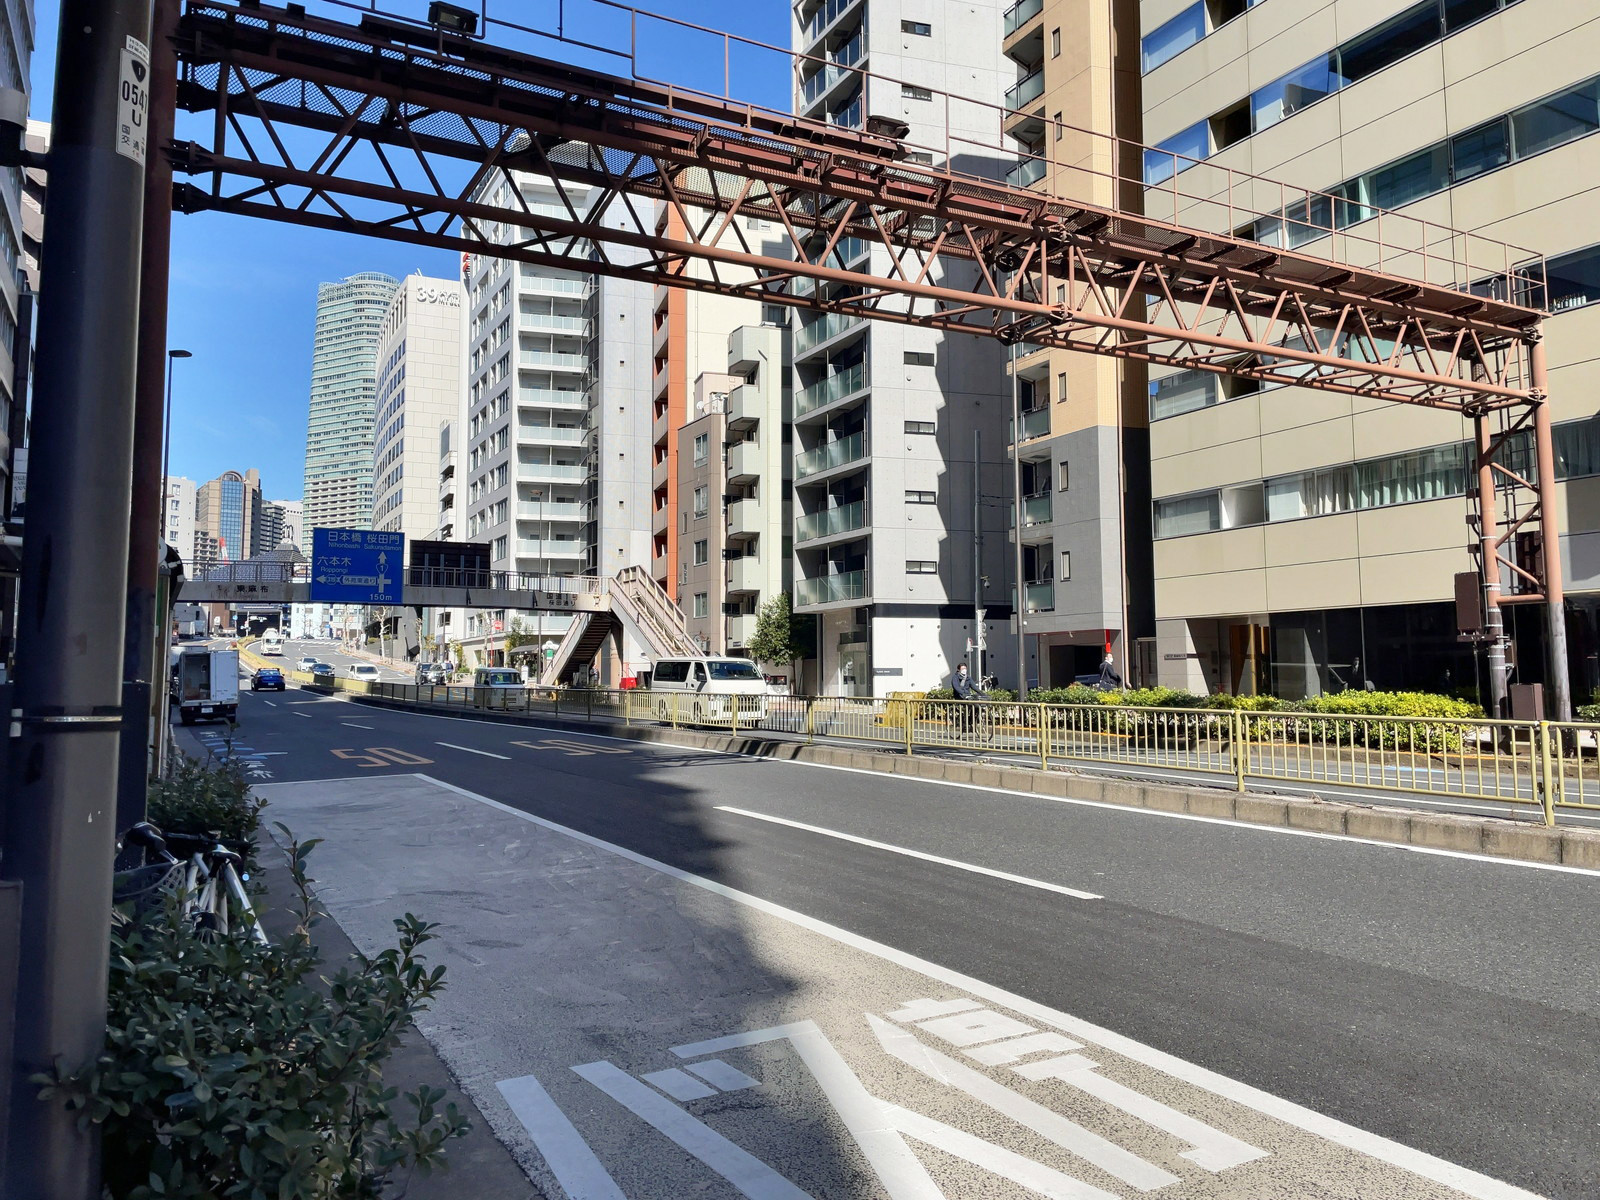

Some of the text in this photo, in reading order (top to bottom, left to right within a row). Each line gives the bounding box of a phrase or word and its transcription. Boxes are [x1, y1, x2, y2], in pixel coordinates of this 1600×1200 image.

[132, 109, 142, 128] U
[328, 531, 400, 545] 日本橋 桜田門
[317, 556, 352, 566] 六本木
[236, 584, 269, 593] 東麻布
[508, 740, 634, 755] 50
[329, 747, 435, 767] 50
